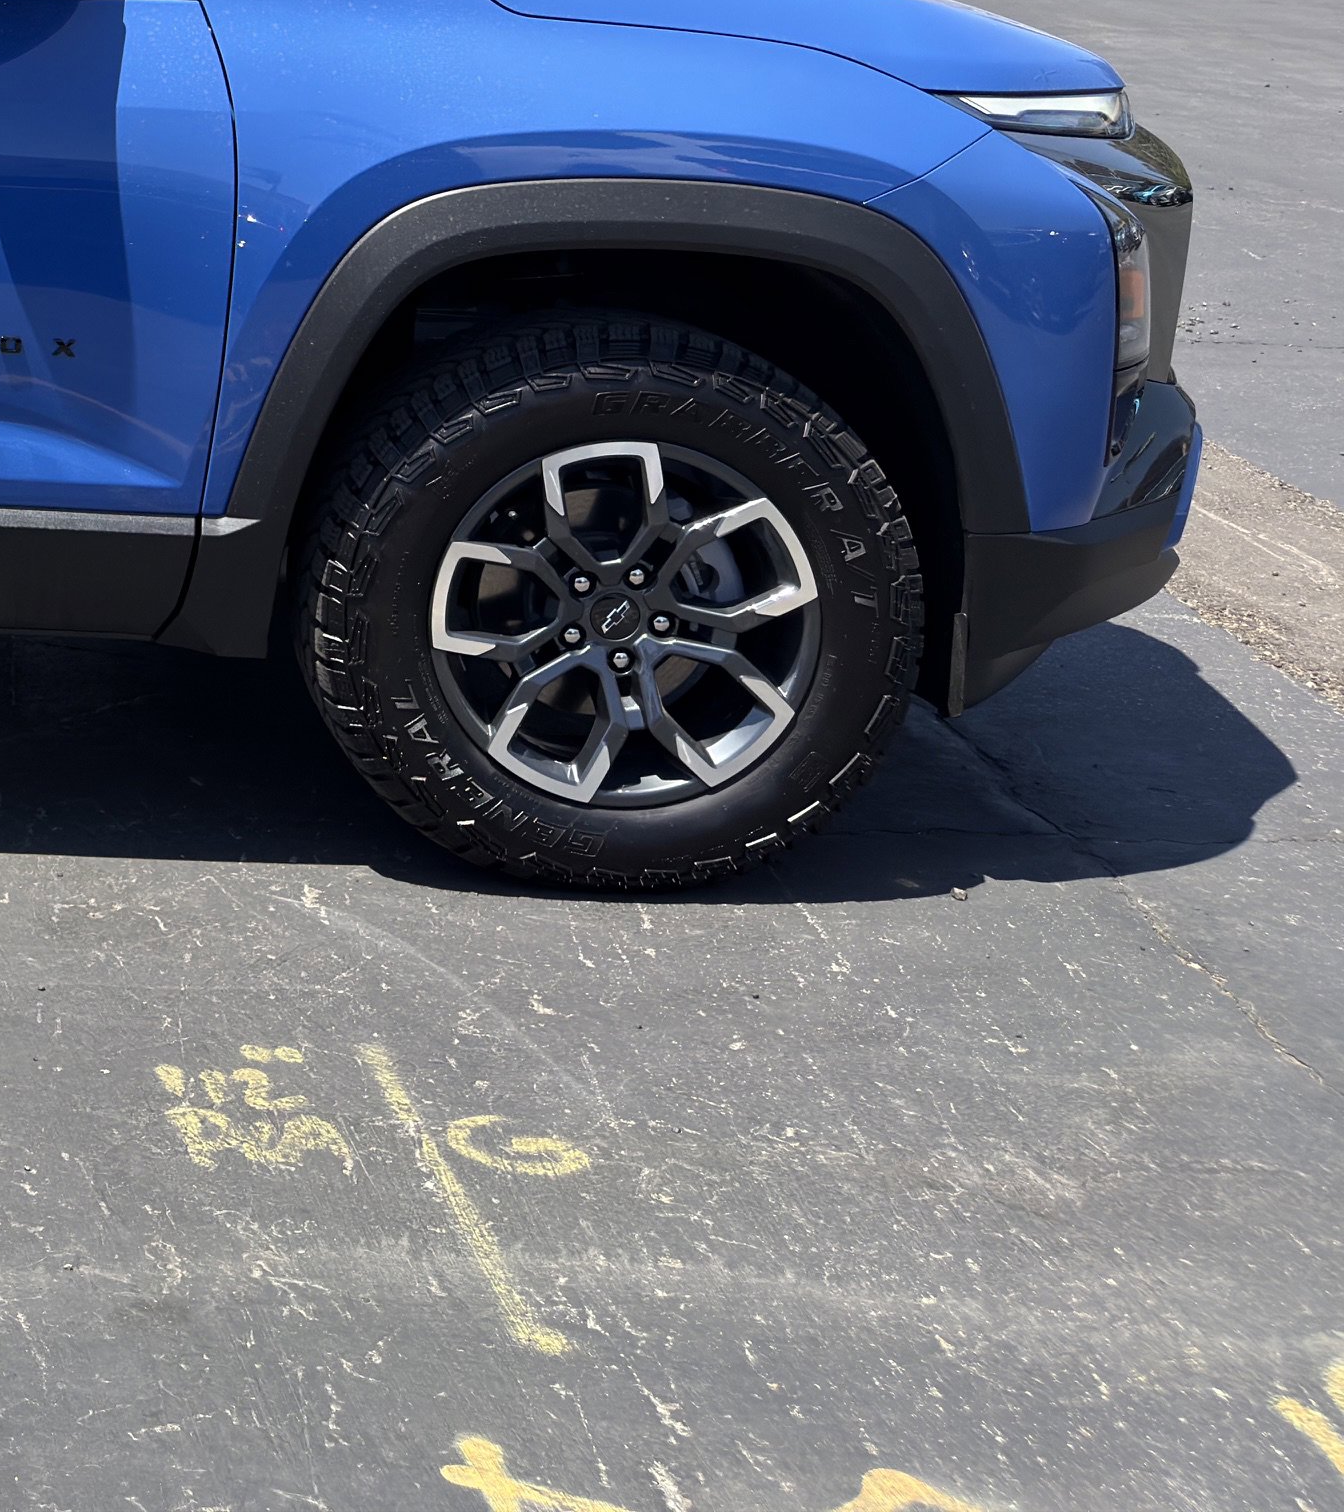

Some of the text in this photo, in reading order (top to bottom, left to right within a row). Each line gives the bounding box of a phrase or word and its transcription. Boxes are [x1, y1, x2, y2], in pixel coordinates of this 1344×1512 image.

[592, 390, 844, 512] GRABBER
[390, 679, 606, 858] GENERAL
[447, 1115, 591, 1176] G
